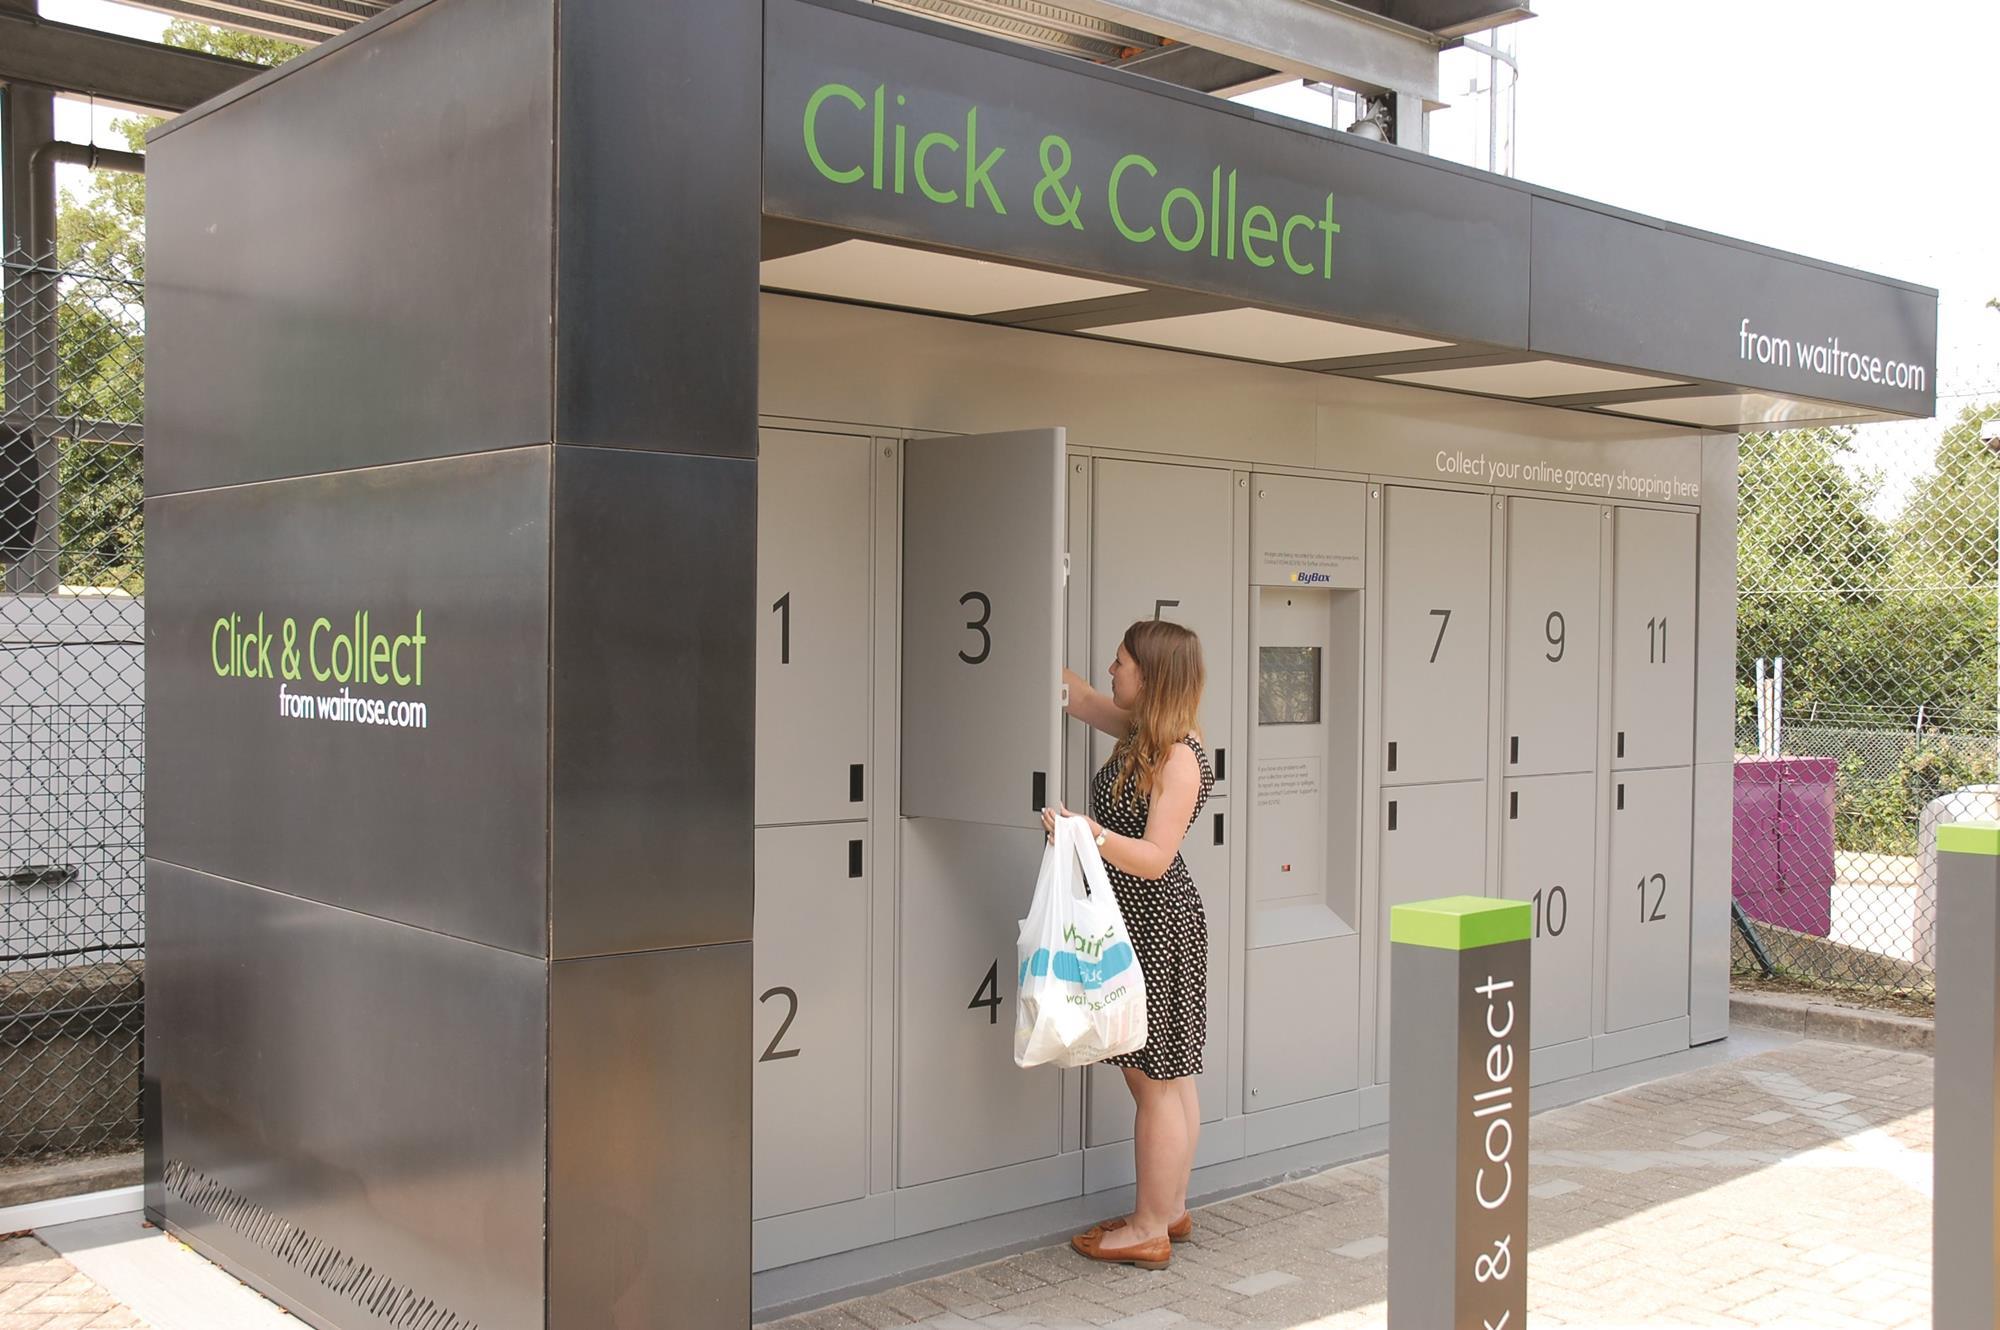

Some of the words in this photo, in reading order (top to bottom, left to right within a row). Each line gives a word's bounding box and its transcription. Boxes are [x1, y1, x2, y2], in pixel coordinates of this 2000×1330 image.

[803, 83, 1008, 215] Click
[1033, 134, 1085, 231] &
[1107, 153, 1342, 280] Collect
[1739, 318, 1791, 368] from
[1796, 336, 1926, 392] waitrose.com
[1435, 450, 1486, 476] Collect
[1488, 461, 1520, 484] your
[1523, 460, 1563, 484] online
[1564, 469, 1615, 496] grocery
[1616, 469, 1672, 501] shopping
[1673, 475, 1700, 498] here
[1297, 571, 1331, 585] ByBox
[211, 610, 275, 680] Click
[280, 616, 303, 681] &
[309, 608, 428, 686] Collect
[772, 591, 790, 665] 1
[957, 590, 992, 665] 3
[1429, 609, 1452, 664] 7
[1545, 610, 1566, 663] 9
[1646, 616, 1667, 664] 11
[279, 682, 315, 720] from
[316, 686, 428, 729] waitrose.com
[1532, 884, 1568, 938] 10
[1637, 872, 1667, 924] 12
[967, 957, 1003, 1025] 4
[758, 986, 801, 1063] 2
[1473, 975, 1515, 1210] Collect
[1475, 1233, 1512, 1283] &
